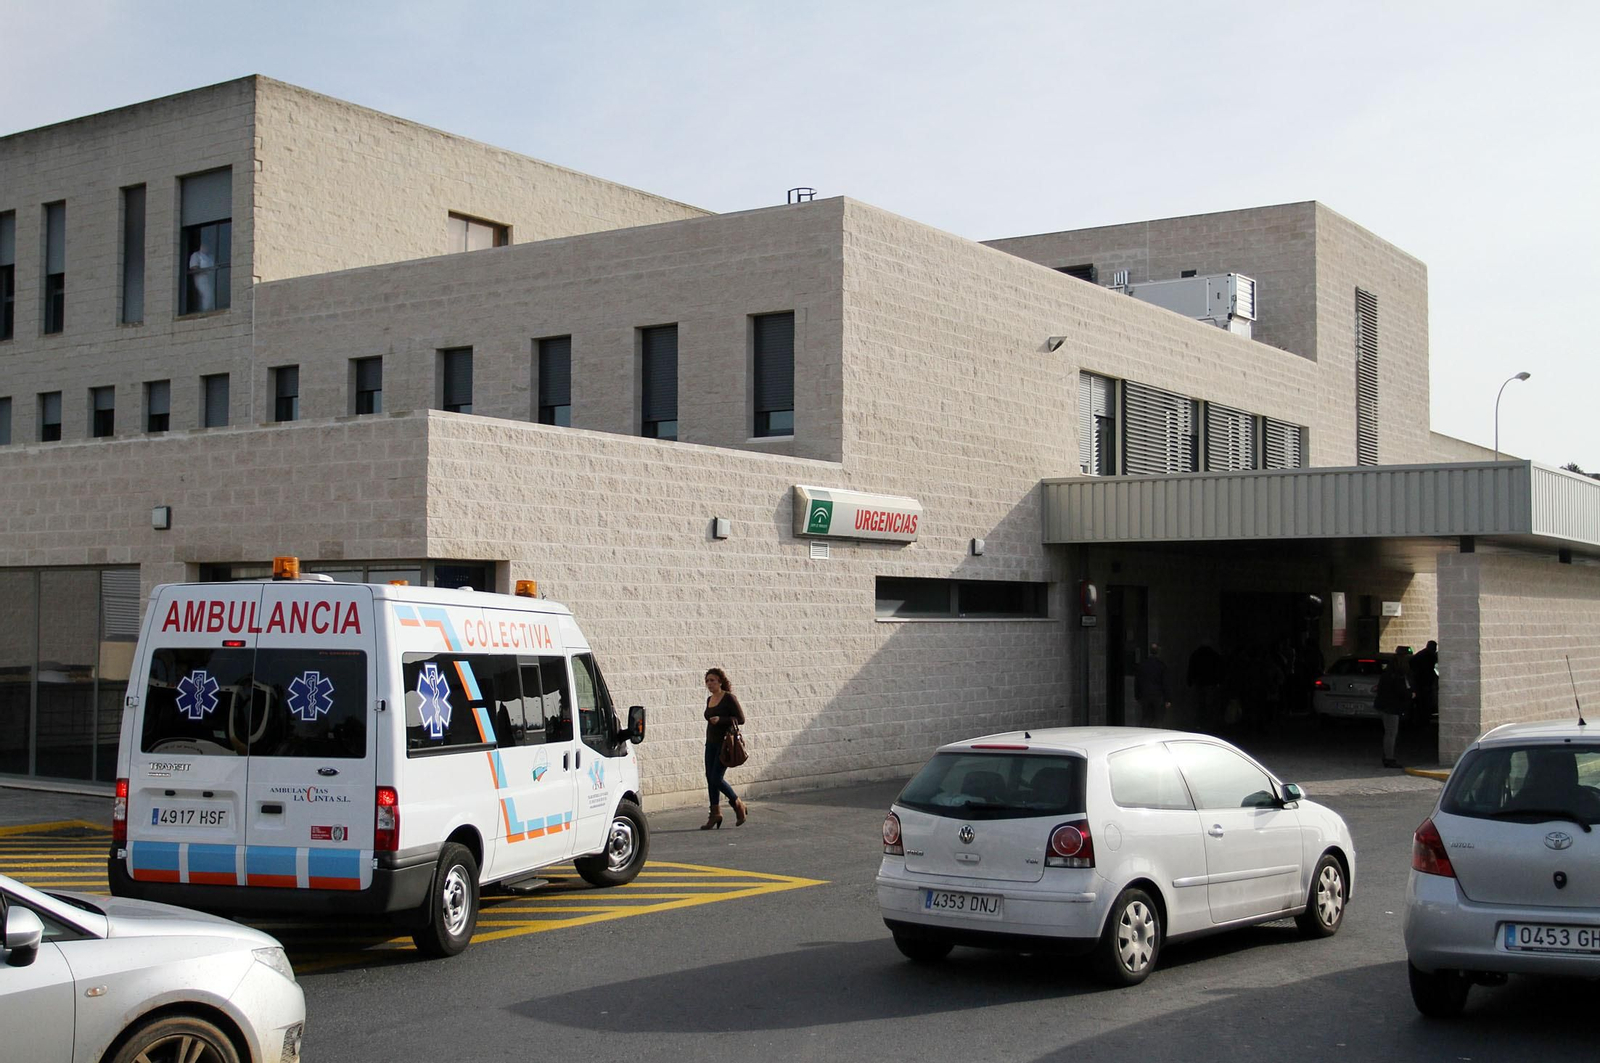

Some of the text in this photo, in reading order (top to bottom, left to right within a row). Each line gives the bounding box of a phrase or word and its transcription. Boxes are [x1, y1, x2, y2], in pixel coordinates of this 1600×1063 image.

[854, 509, 918, 534] URGENCIAS
[162, 600, 362, 635] AMBULANCIA
[464, 619, 553, 649] COLECTIVA
[149, 762, 191, 771] TRANSIT
[307, 786, 335, 803] CINTA
[161, 810, 226, 825] 4917 HSF
[933, 893, 998, 913] 4353 DNJ
[1520, 927, 1600, 948] 0453 GH
